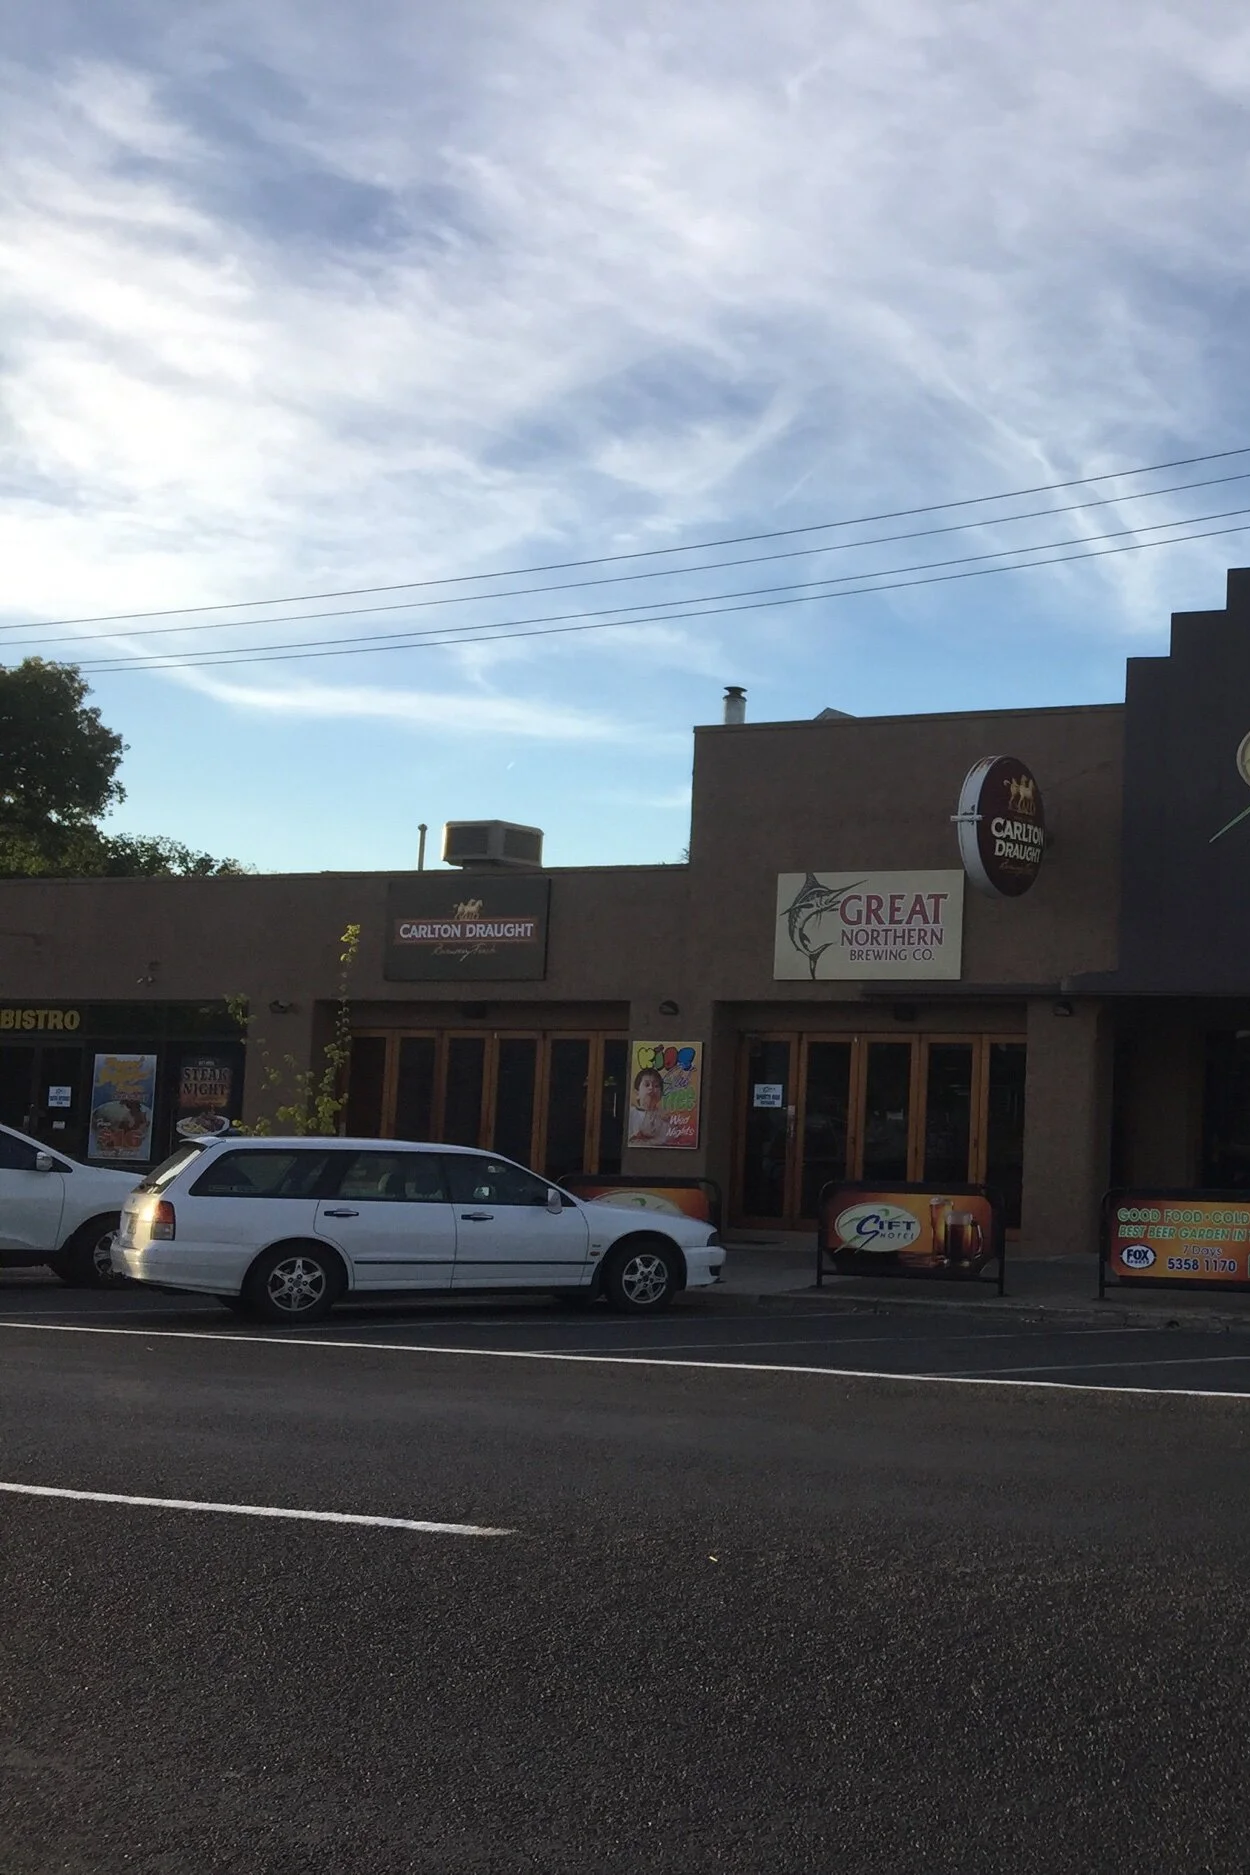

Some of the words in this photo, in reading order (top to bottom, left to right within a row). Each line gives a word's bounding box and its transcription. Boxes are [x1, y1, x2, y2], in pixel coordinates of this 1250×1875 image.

[990, 816, 1044, 847] CARLTON
[994, 838, 1041, 863] DRAUGHT
[839, 893, 949, 926] GREAT
[399, 924, 461, 938] CARLTON
[465, 923, 534, 938] DRAUGHT
[841, 928, 944, 946] NORTHERN
[850, 949, 907, 960] BREWING
[913, 948, 935, 960] CO.
[0, 1009, 81, 1030] BISTRO
[183, 1067, 230, 1081] STEAK
[183, 1083, 226, 1096] NIGHT
[1117, 1208, 1160, 1222] GOOD
[1164, 1209, 1204, 1224] FOOD
[1212, 1211, 1250, 1225] COLD
[853, 1214, 916, 1255] GIFT
[879, 1232, 914, 1240] HOTEL
[1118, 1225, 1145, 1238] BEST
[1148, 1226, 1176, 1239] BEER
[1179, 1227, 1230, 1241] GARDEN
[1232, 1229, 1247, 1241] IN
[1126, 1249, 1149, 1260] FOX
[1183, 1245, 1189, 1255] 7
[1191, 1245, 1222, 1258] Days
[1167, 1258, 1199, 1271] 5358
[1204, 1259, 1237, 1273] 1170
